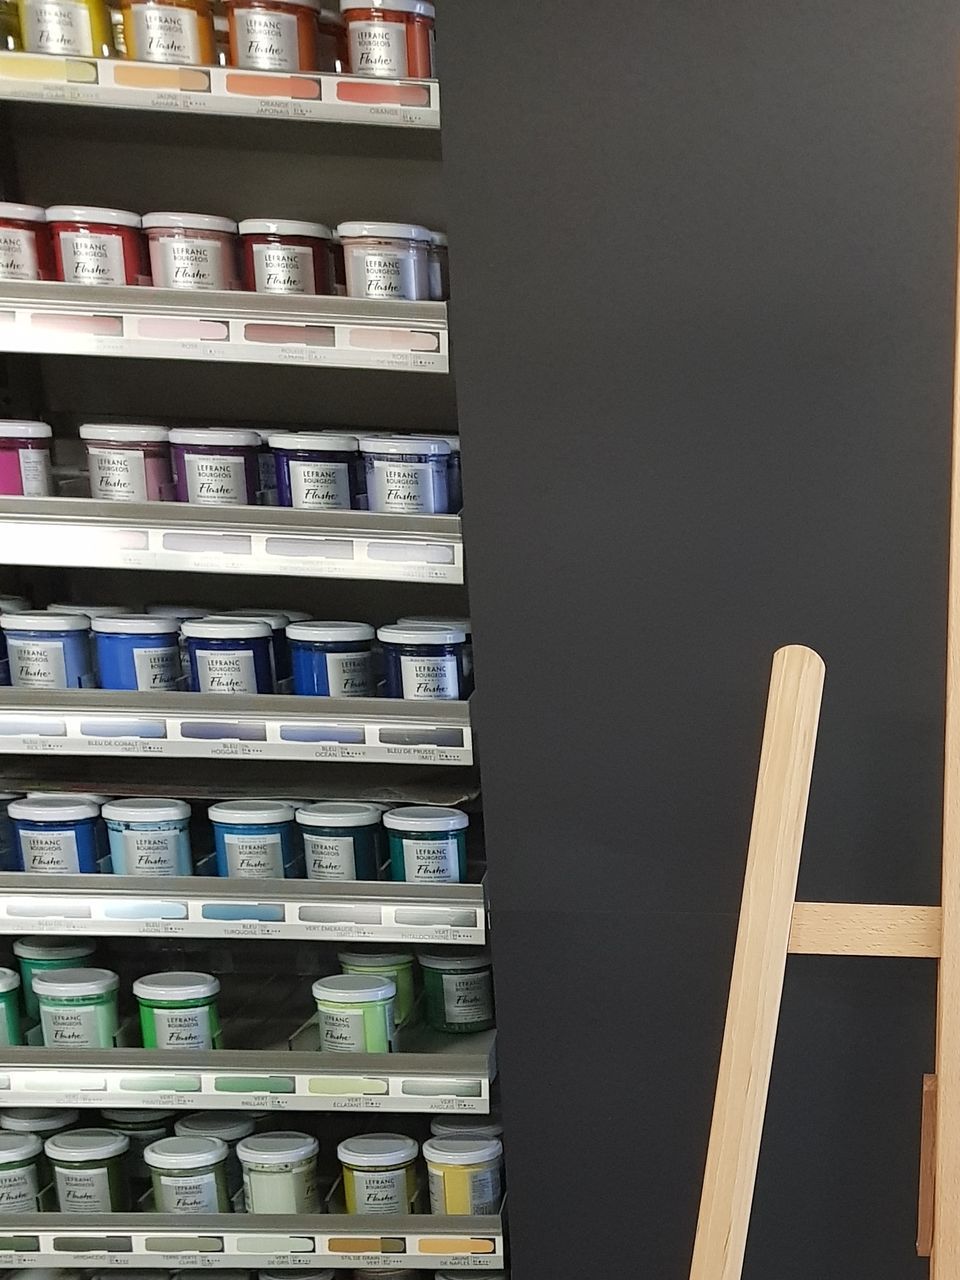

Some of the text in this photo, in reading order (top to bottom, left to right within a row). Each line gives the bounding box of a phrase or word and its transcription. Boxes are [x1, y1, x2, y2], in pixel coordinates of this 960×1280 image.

[358, 32, 390, 41] LEFRANC
[358, 39, 391, 48] BOURGEOIS
[360, 52, 391, 66] Flashe
[370, 108, 398, 116] ORANGE
[172, 248, 208, 257] LEFRANC
[173, 254, 209, 263] BOURGEOIS
[265, 254, 298, 263] LEFRANC
[366, 260, 401, 269] LEFRANC
[174, 267, 208, 279] Flashe
[267, 273, 298, 286] Flashe
[368, 280, 400, 292] Flashe
[98, 458, 129, 467] LEFRANC
[197, 465, 231, 473] LEFRANC
[198, 471, 232, 479] BOURGEOIS
[303, 470, 336, 478] LEFRANC
[386, 471, 419, 479] LEFRANC
[99, 476, 130, 489] Flashe
[304, 477, 337, 485] BOURGEOIS
[199, 483, 232, 494] Flashe
[304, 489, 337, 500] Flashe
[387, 489, 418, 500] Flashe
[207, 659, 241, 667] LEFRANC
[415, 665, 446, 673] LEFRANC
[416, 682, 447, 693] Flashe
[417, 865, 447, 875] Flashe
